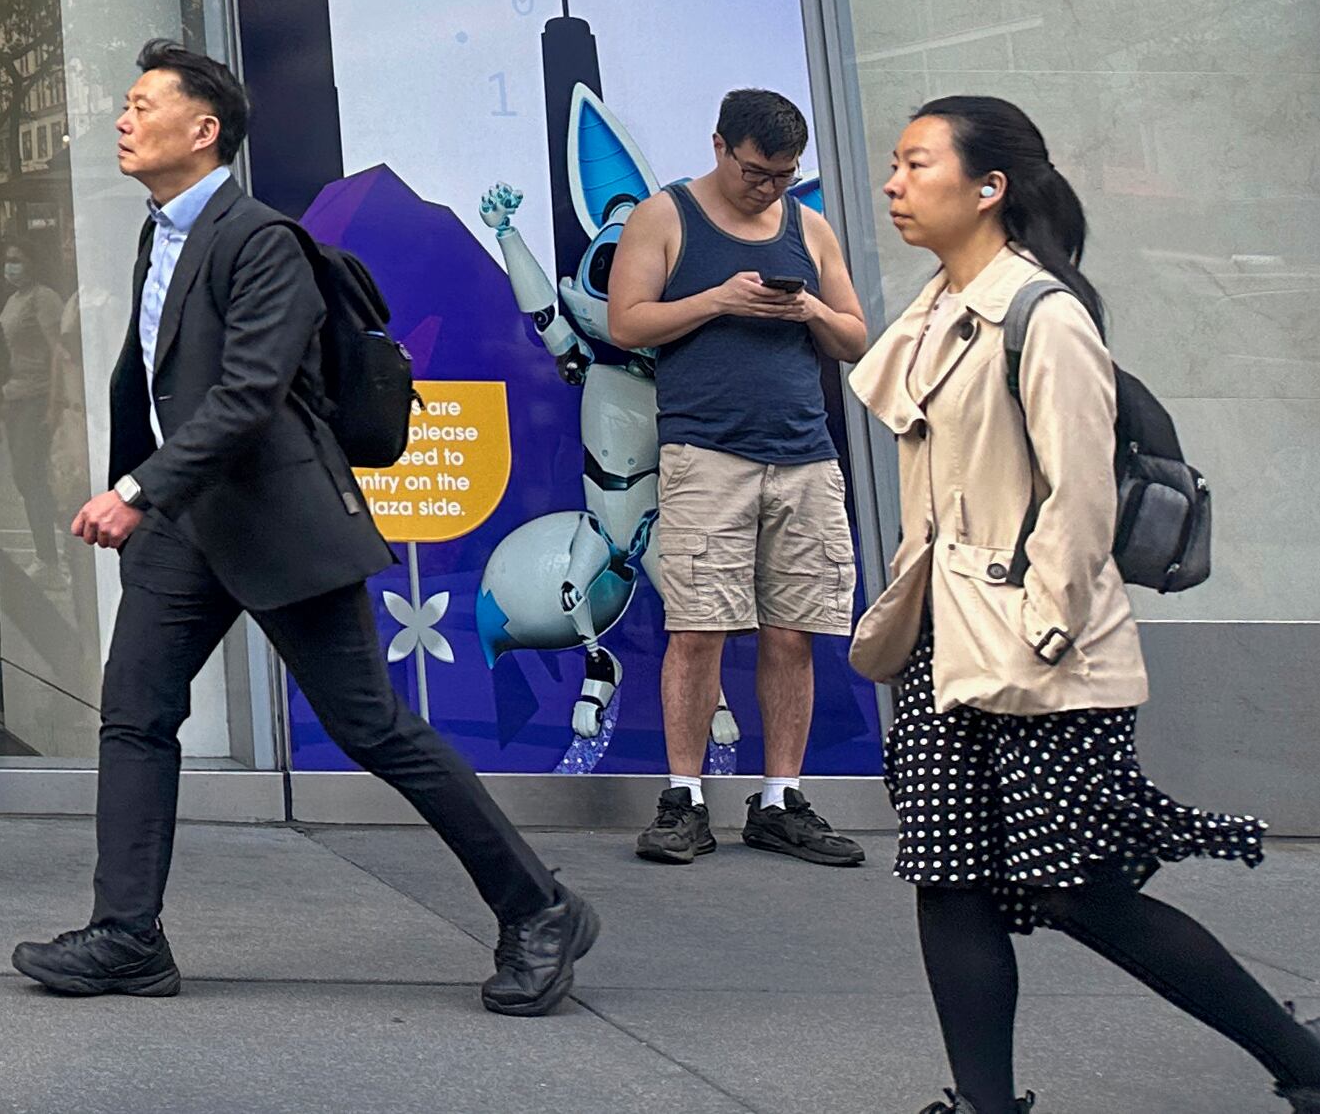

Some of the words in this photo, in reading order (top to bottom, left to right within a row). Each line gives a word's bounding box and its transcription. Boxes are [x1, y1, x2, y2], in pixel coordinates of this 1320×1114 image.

[488, 70, 517, 116] 1
[426, 401, 460, 415] are
[408, 422, 477, 442] please
[398, 446, 437, 464] eed
[443, 447, 463, 464] to
[404, 475, 430, 489] on
[436, 472, 469, 490] the
[368, 496, 411, 514] laza
[418, 497, 465, 515] side.
